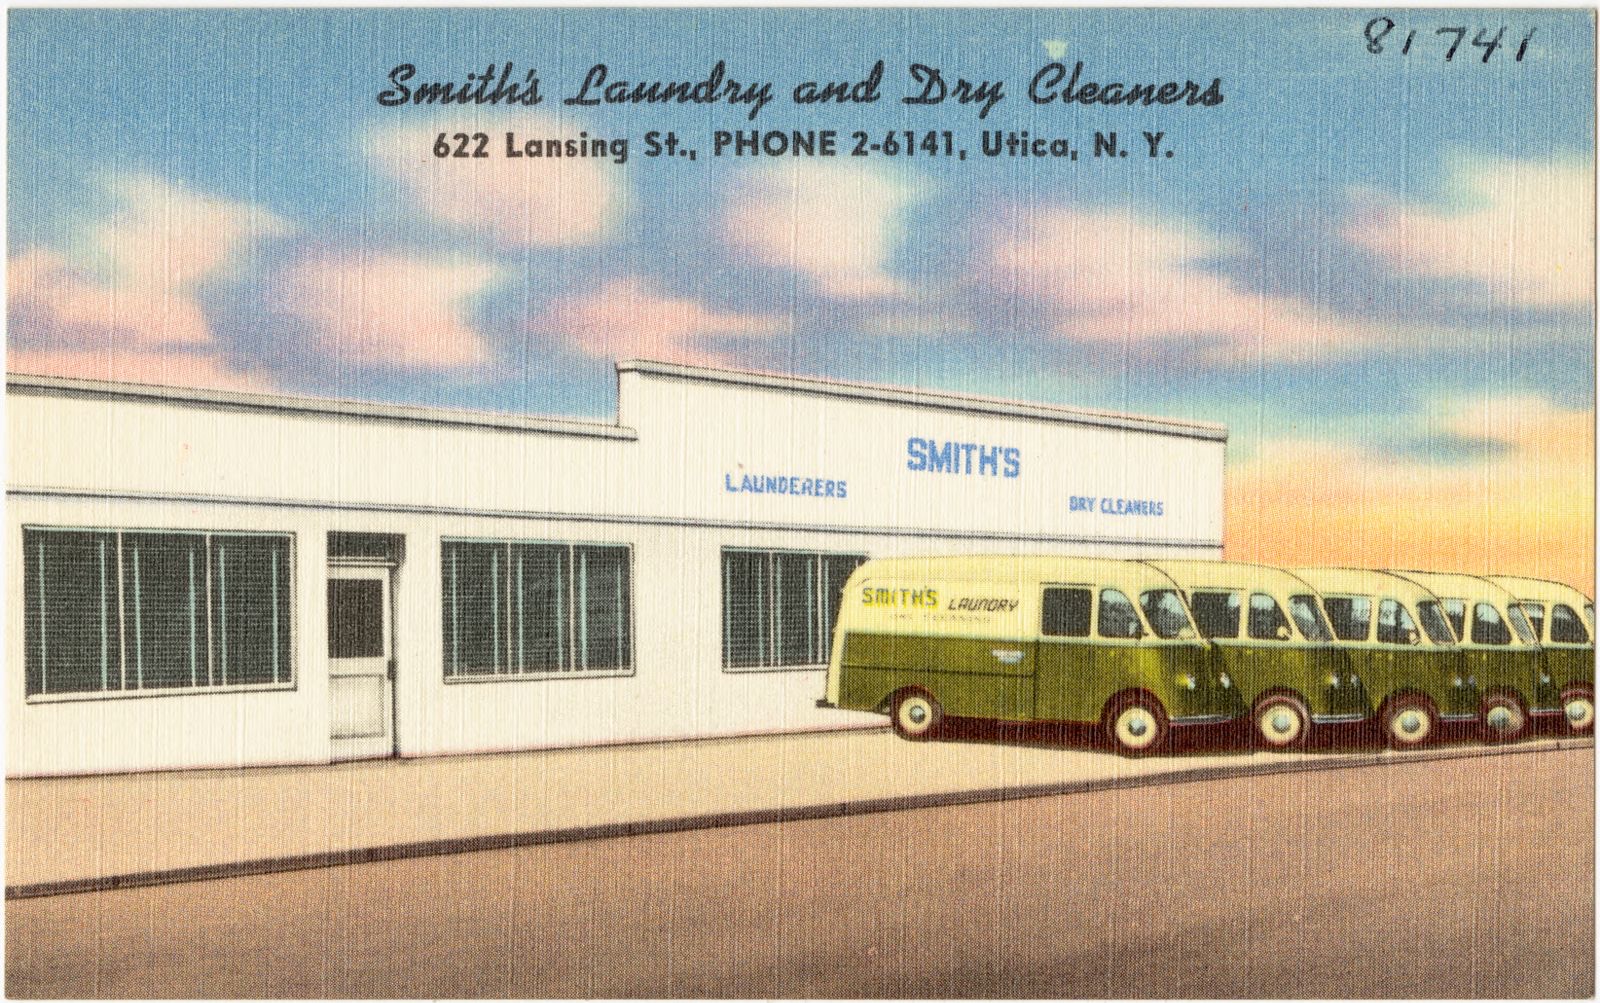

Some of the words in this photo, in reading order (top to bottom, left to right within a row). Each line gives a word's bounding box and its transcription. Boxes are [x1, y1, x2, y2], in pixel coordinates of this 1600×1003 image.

[907, 436, 1020, 479] SMITH'S
[725, 474, 848, 498] LAUNDERERS
[1069, 495, 1096, 513] DRY
[1100, 497, 1164, 517] CLEANERS
[861, 585, 939, 609] SMITH'S
[947, 597, 1020, 613] LAUNDRY
